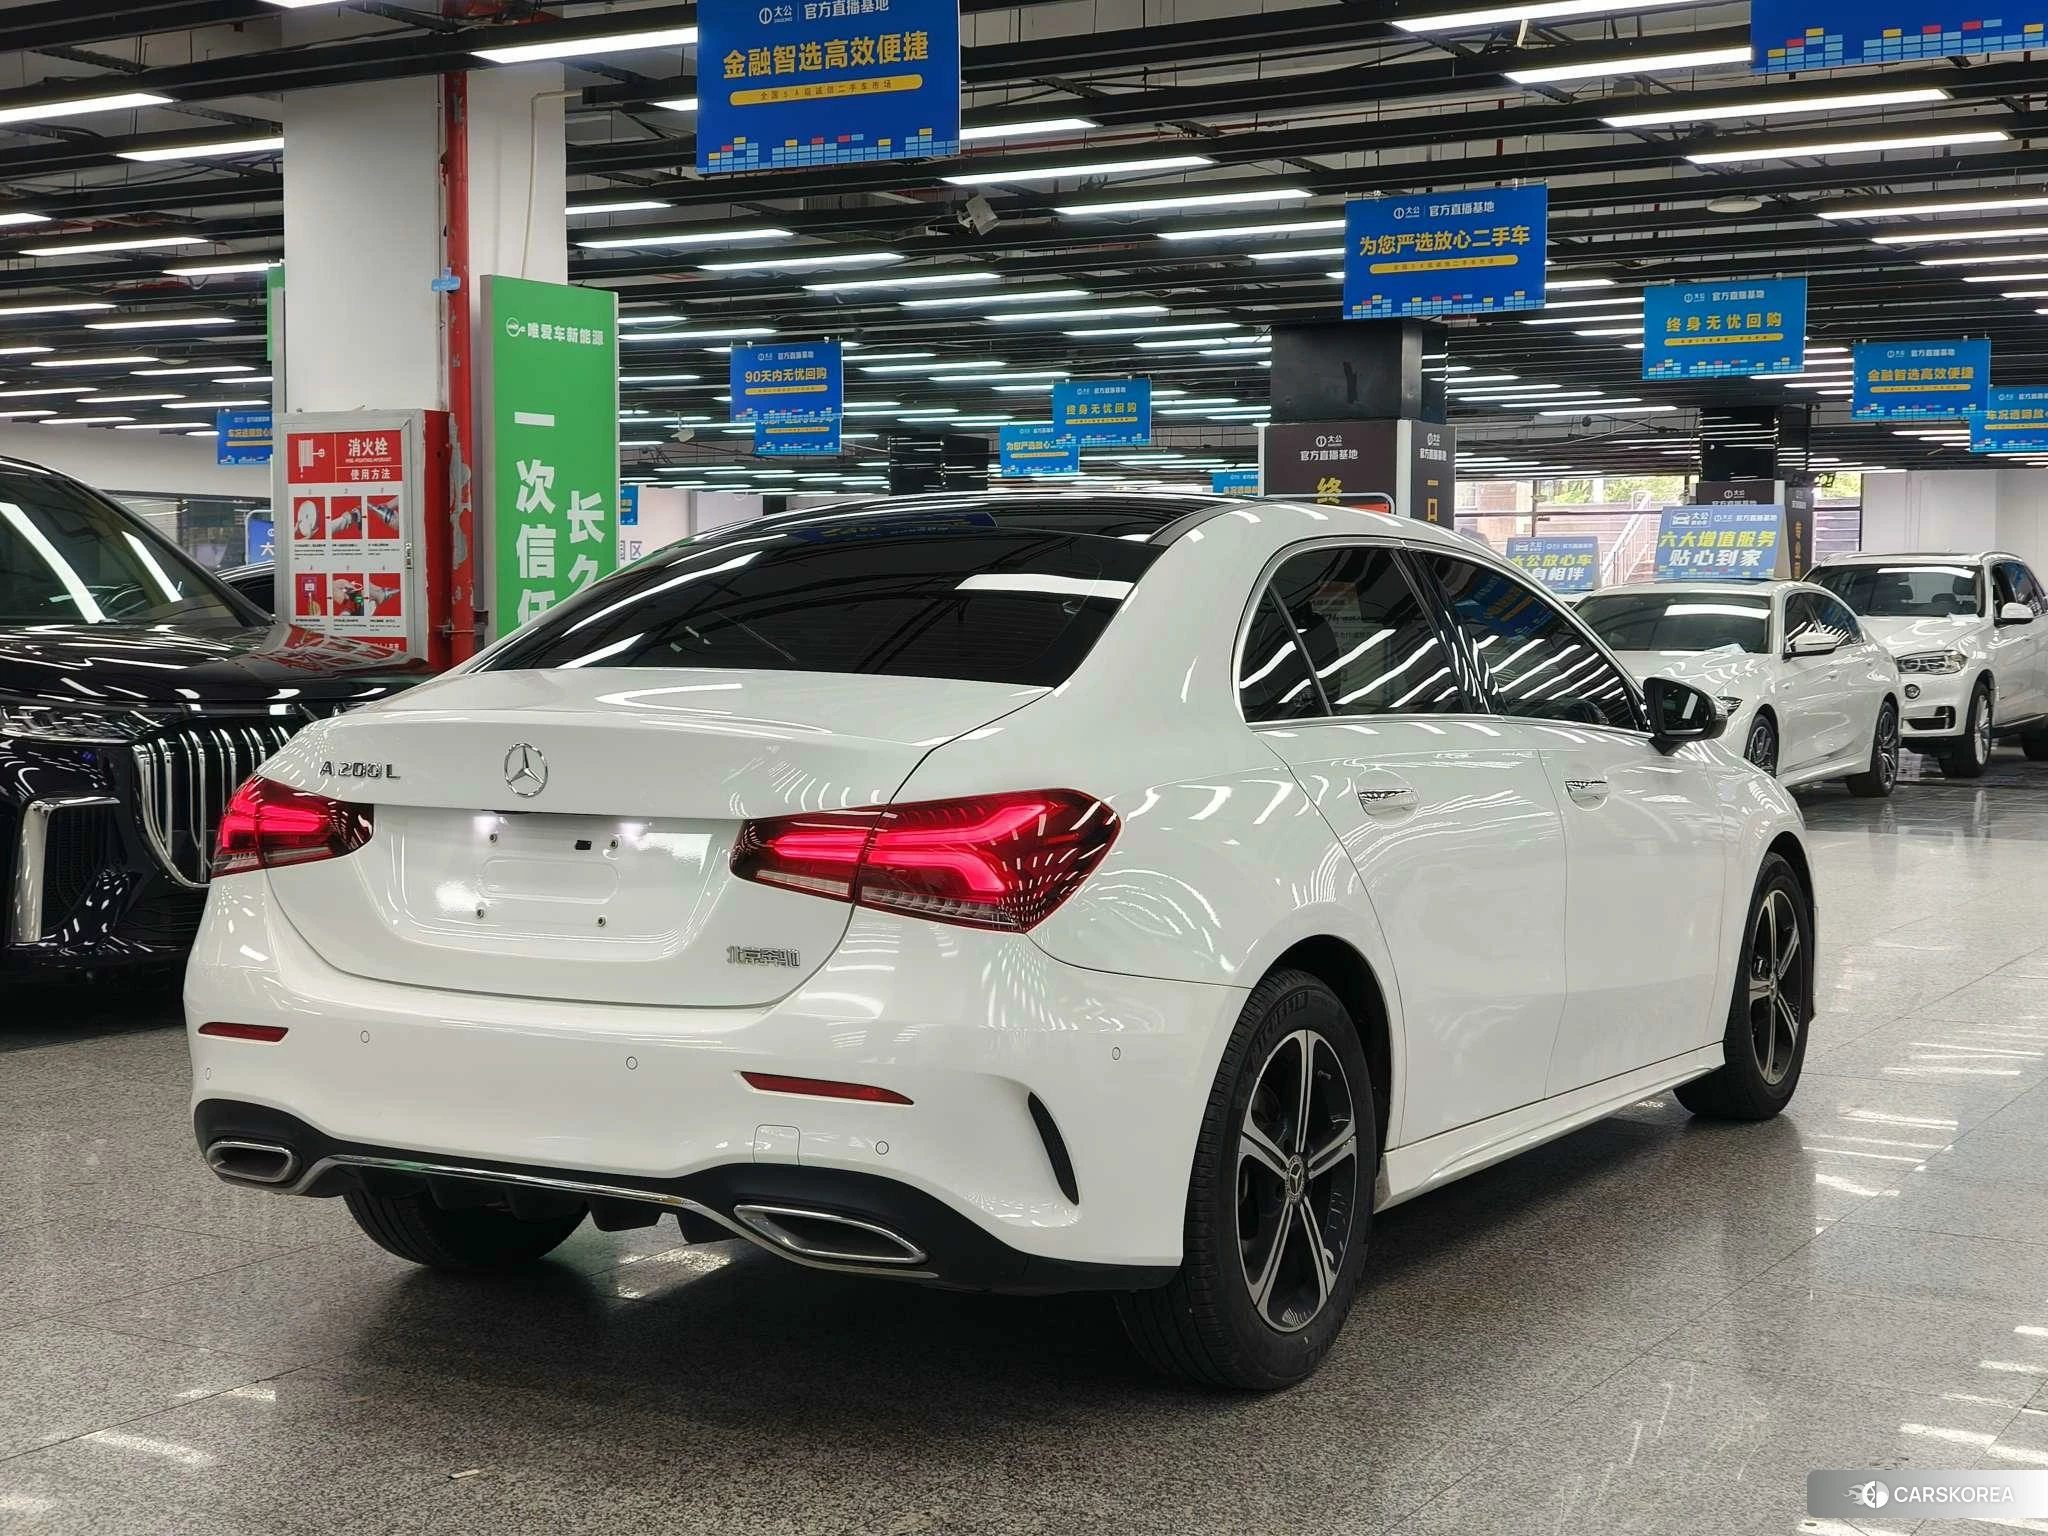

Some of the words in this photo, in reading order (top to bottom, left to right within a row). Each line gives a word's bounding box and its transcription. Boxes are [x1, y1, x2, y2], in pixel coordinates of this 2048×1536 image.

[773, 5, 792, 17] 大公
[804, 0, 889, 20] 官方直播基地
[723, 31, 929, 79] 金融智选高效便捷
[1429, 201, 1495, 217] 官方直播基地
[1359, 225, 1531, 257] 为您严选放心二手车
[1666, 312, 1783, 333] 终身无忧回购
[527, 322, 604, 346] 唯爱车新能源
[745, 367, 828, 383] 90天内无忧回购
[1867, 367, 1975, 382] 金融智选高效便捷
[348, 437, 388, 457] 消火栓
[1327, 435, 1344, 445] 大公
[1300, 449, 1359, 461] 官方直播基地
[350, 468, 391, 480] 使用方法
[514, 411, 557, 627] 一次信任
[567, 491, 606, 587] 长久
[1659, 530, 1777, 548] 六大增值服务
[1668, 549, 1763, 567] 贴心到家
[1525, 567, 1585, 581] 身相伴
[320, 760, 334, 776] A
[338, 762, 382, 778] 200
[386, 764, 401, 779] L
[726, 945, 800, 968] 北京奔驰
